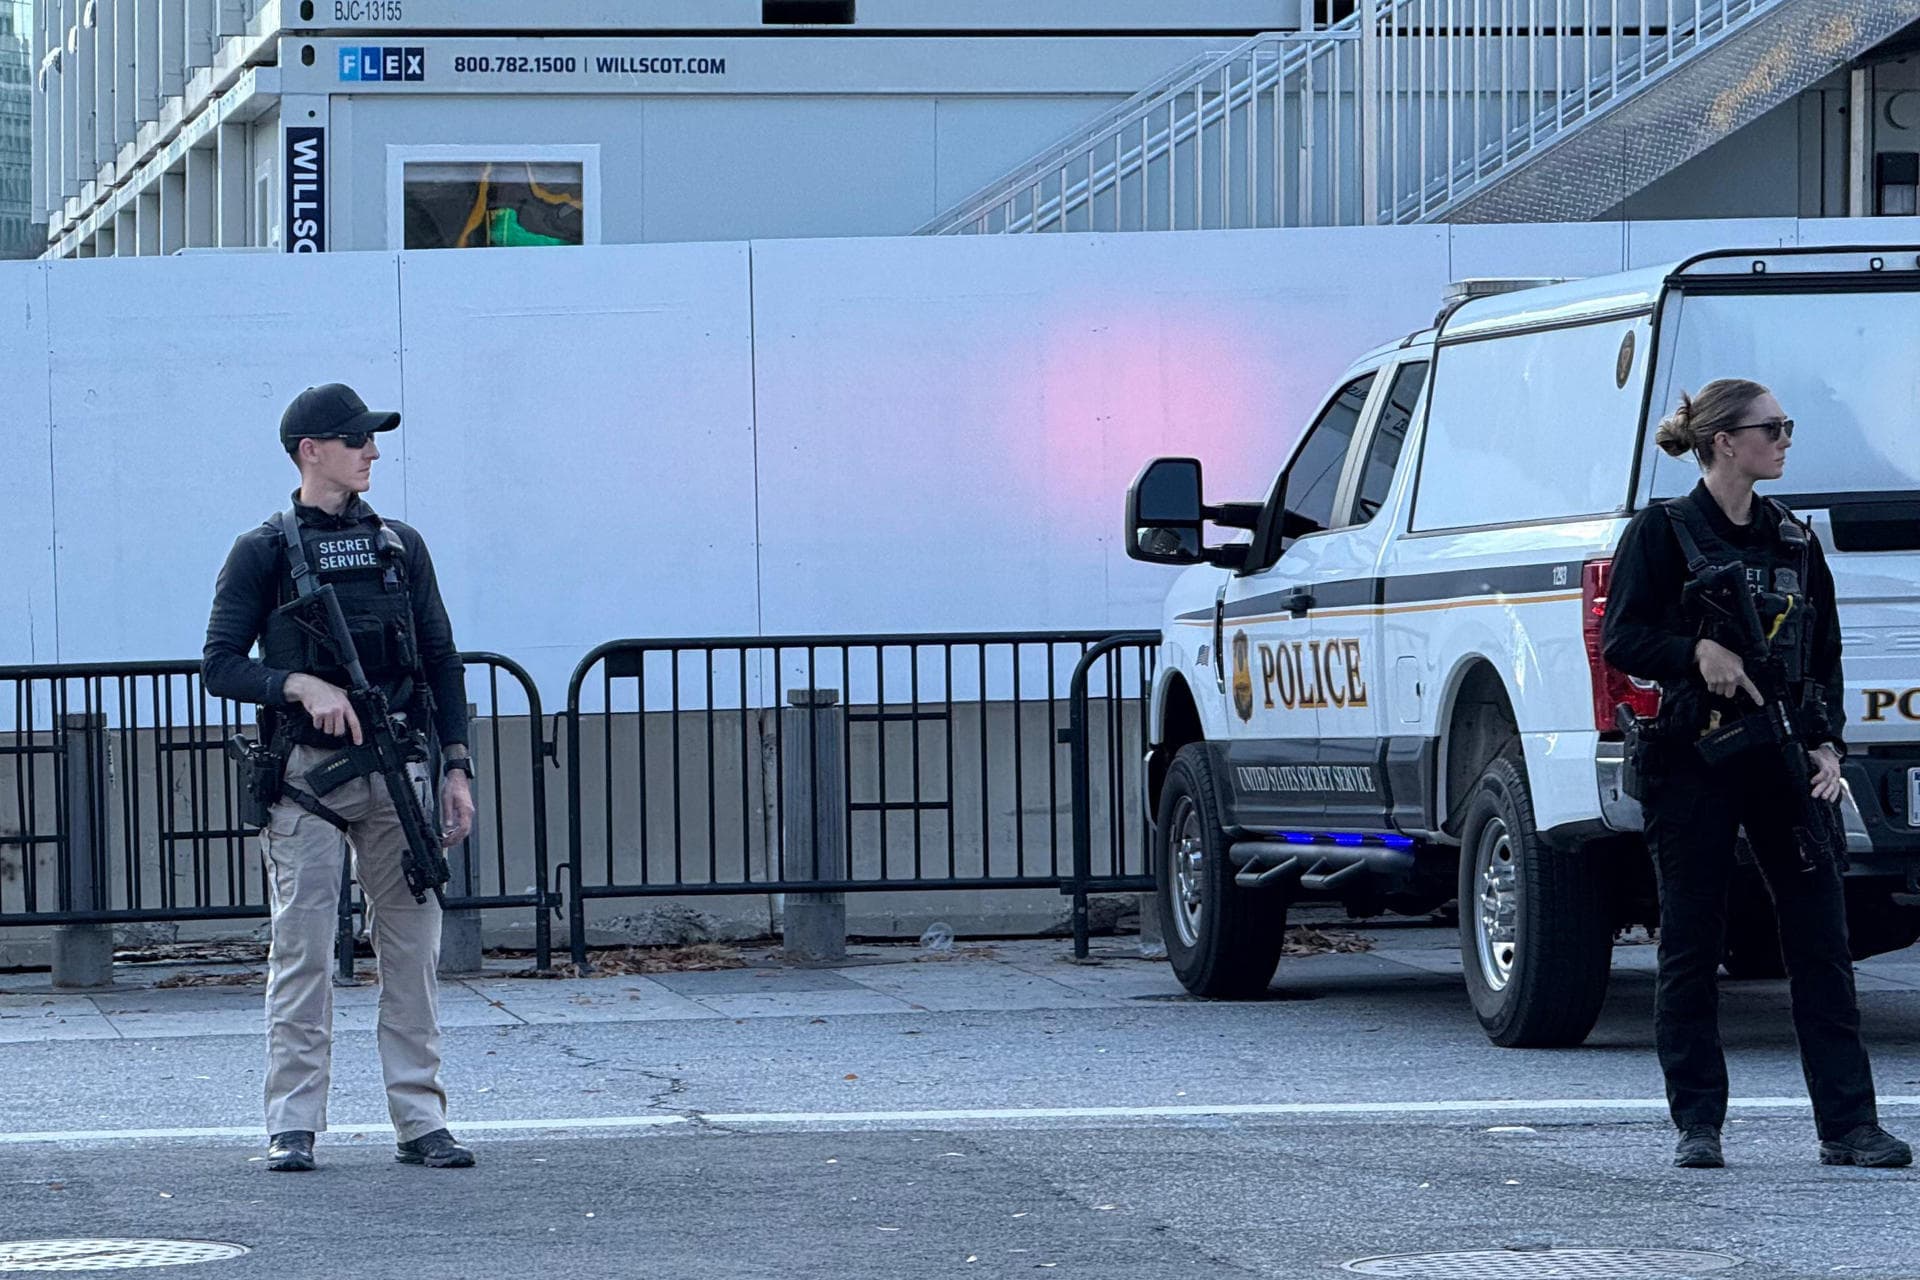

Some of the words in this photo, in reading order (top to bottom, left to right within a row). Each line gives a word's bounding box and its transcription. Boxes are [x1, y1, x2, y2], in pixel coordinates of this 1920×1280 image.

[335, 0, 402, 21] BJC-13155
[342, 54, 422, 75] FLEX
[454, 56, 576, 73] 800.782.1500
[596, 57, 726, 74] WILLSCOT.COM
[319, 538, 370, 553] SECRET
[319, 553, 376, 569] SERVICE
[1258, 638, 1368, 709] POLICE
[1237, 766, 1270, 791] UNITED
[1268, 766, 1300, 791] STATES
[1298, 766, 1335, 791] SECRET
[1333, 766, 1376, 792] SERVICE
